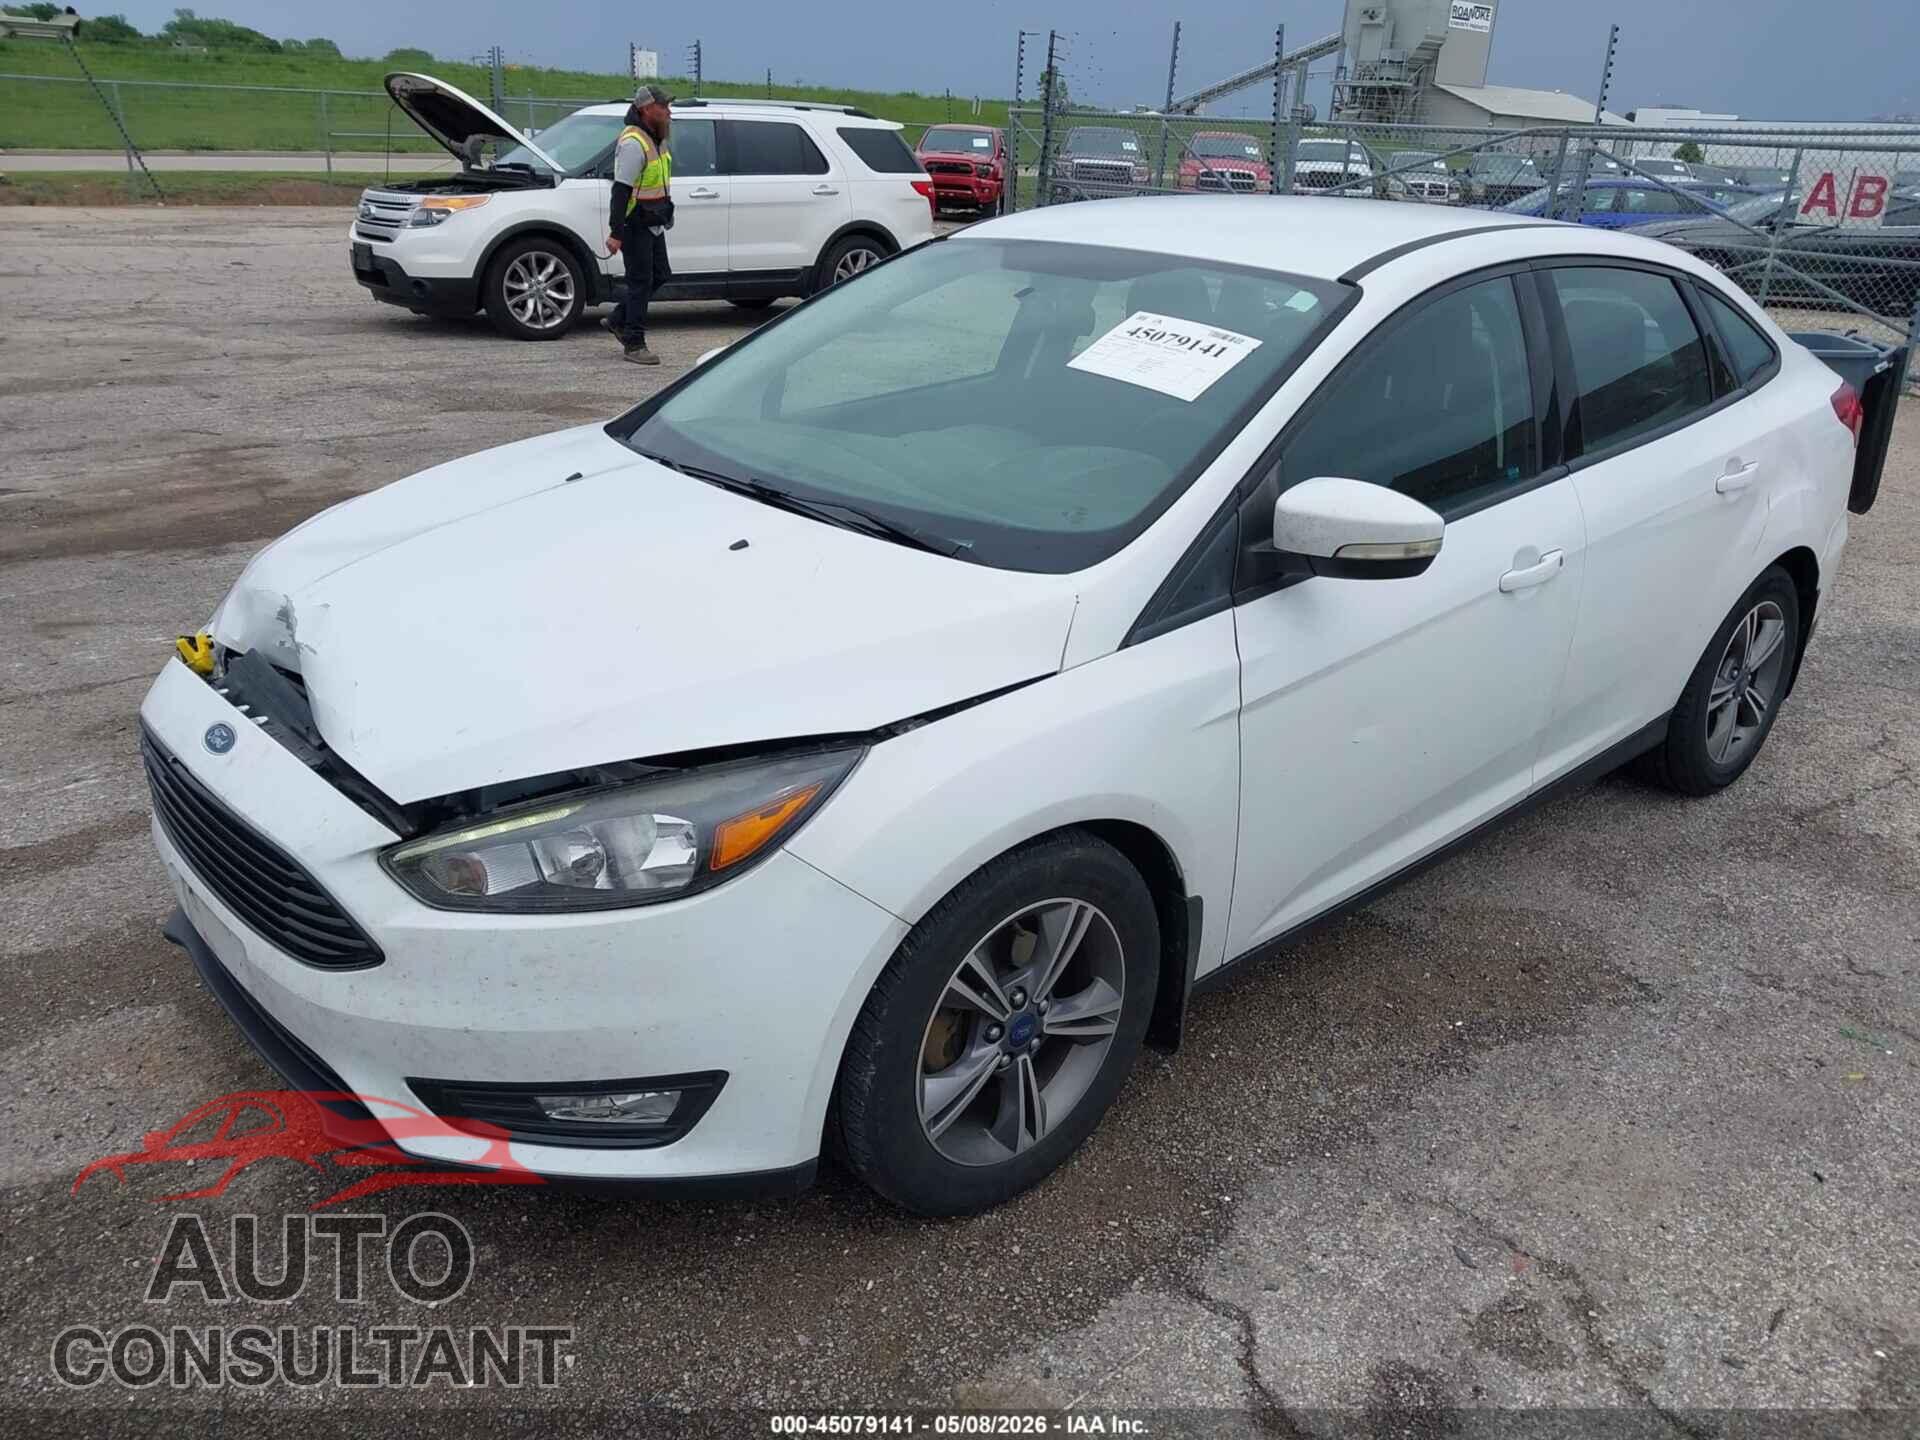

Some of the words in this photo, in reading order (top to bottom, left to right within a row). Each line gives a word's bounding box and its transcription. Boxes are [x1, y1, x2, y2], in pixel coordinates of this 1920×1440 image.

[1452, 5, 1490, 20] ROANOKE
[1800, 172, 1837, 216] A
[1849, 175, 1888, 217] B
[1126, 326, 1229, 359] 45079141
